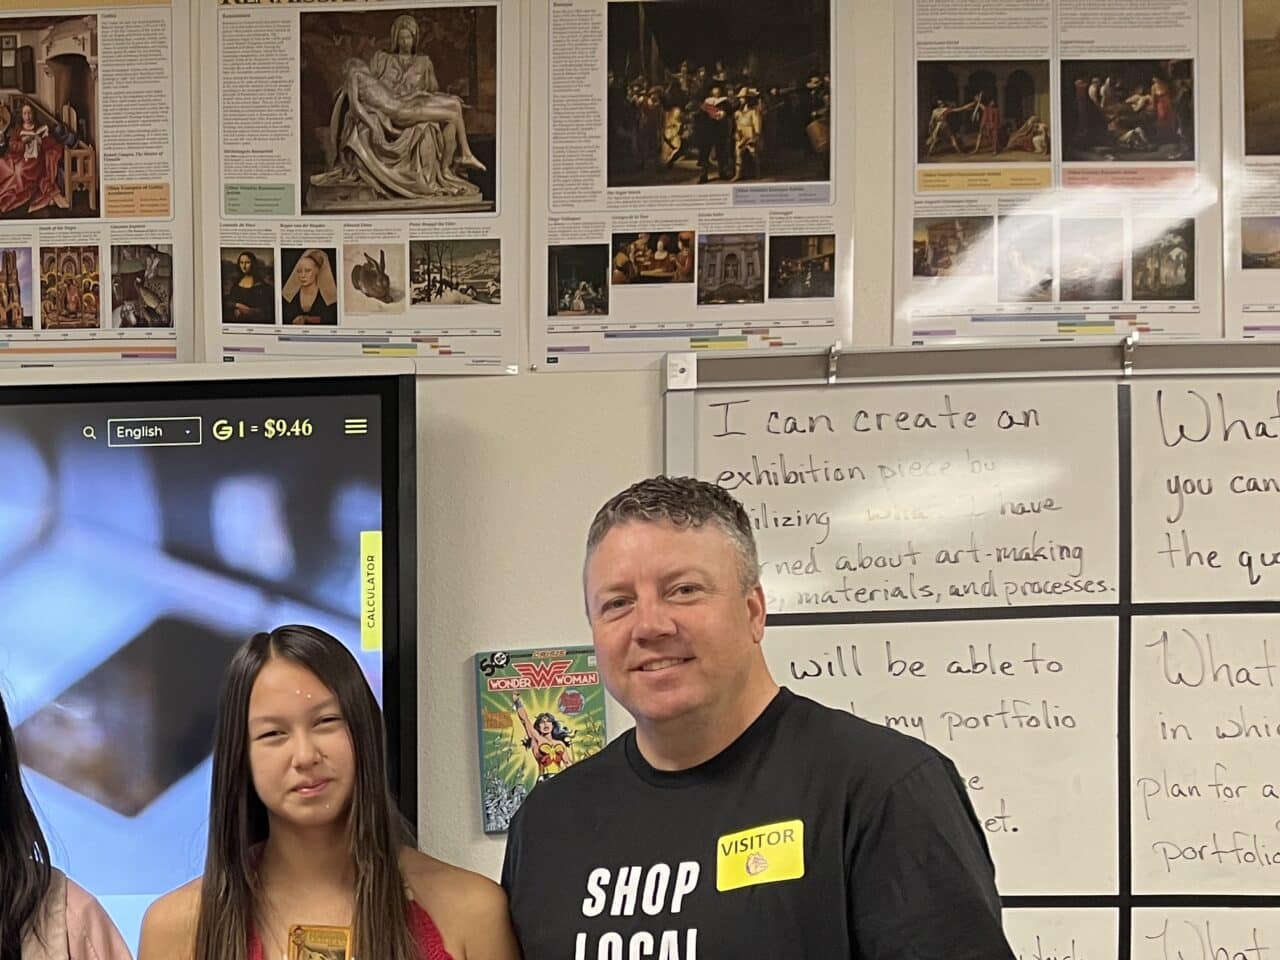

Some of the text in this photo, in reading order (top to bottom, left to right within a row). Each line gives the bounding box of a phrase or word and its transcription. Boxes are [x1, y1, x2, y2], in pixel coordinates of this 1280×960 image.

[116, 424, 163, 440] English
[264, 418, 313, 438] $9.46
[708, 394, 1041, 438] I can create an
[716, 452, 866, 490] exhibition
[999, 486, 1063, 516] have
[1166, 475, 1213, 524] you
[835, 540, 921, 571] about
[935, 530, 1084, 578] art-making
[1157, 529, 1222, 569] the
[367, 554, 376, 629] CALCULATOR
[797, 573, 943, 606] materials,
[948, 569, 998, 599] and
[1004, 576, 1116, 605] processes.
[790, 640, 1064, 681] will be able to
[1145, 627, 1277, 688] What
[489, 673, 596, 689] WONDER WOMAN
[885, 699, 1077, 741] my portfolio
[1159, 711, 1193, 741] in
[1136, 762, 1280, 821] plan for a
[721, 827, 795, 857] VISITOR
[581, 860, 701, 918] SHOP
